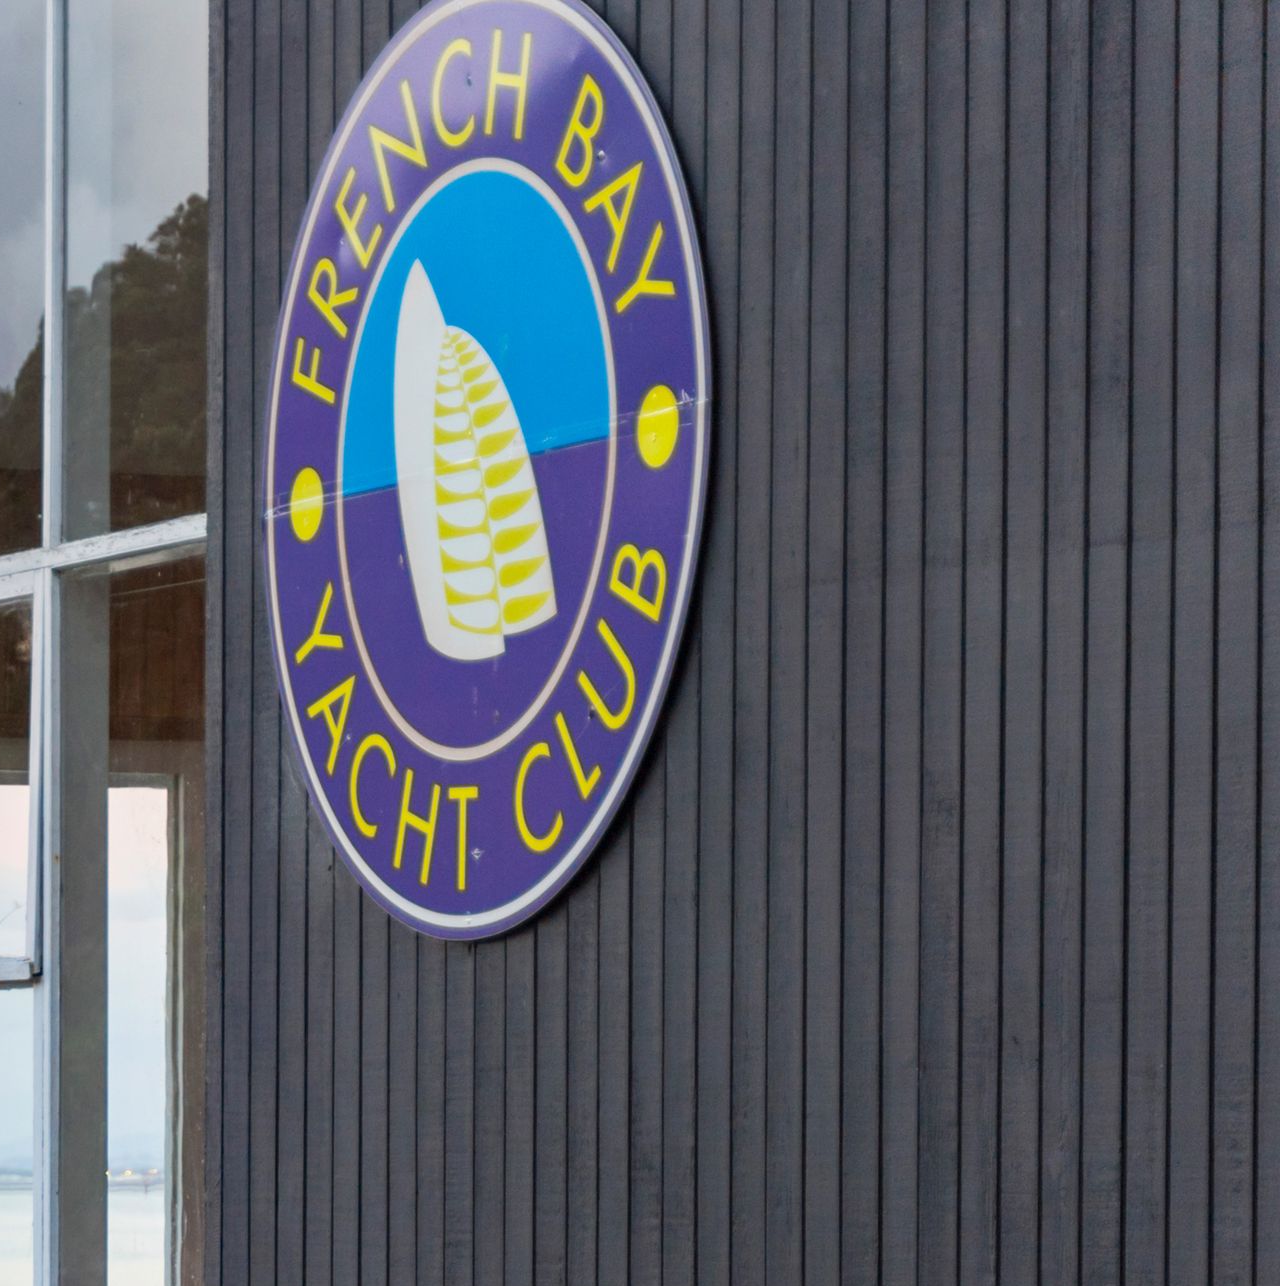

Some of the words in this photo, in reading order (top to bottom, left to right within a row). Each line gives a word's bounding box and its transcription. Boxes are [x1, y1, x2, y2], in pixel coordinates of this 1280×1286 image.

[293, 29, 531, 404] FRENCH
[554, 73, 677, 314] BAY
[294, 582, 479, 892] YACHT
[512, 542, 668, 853] CLUB
